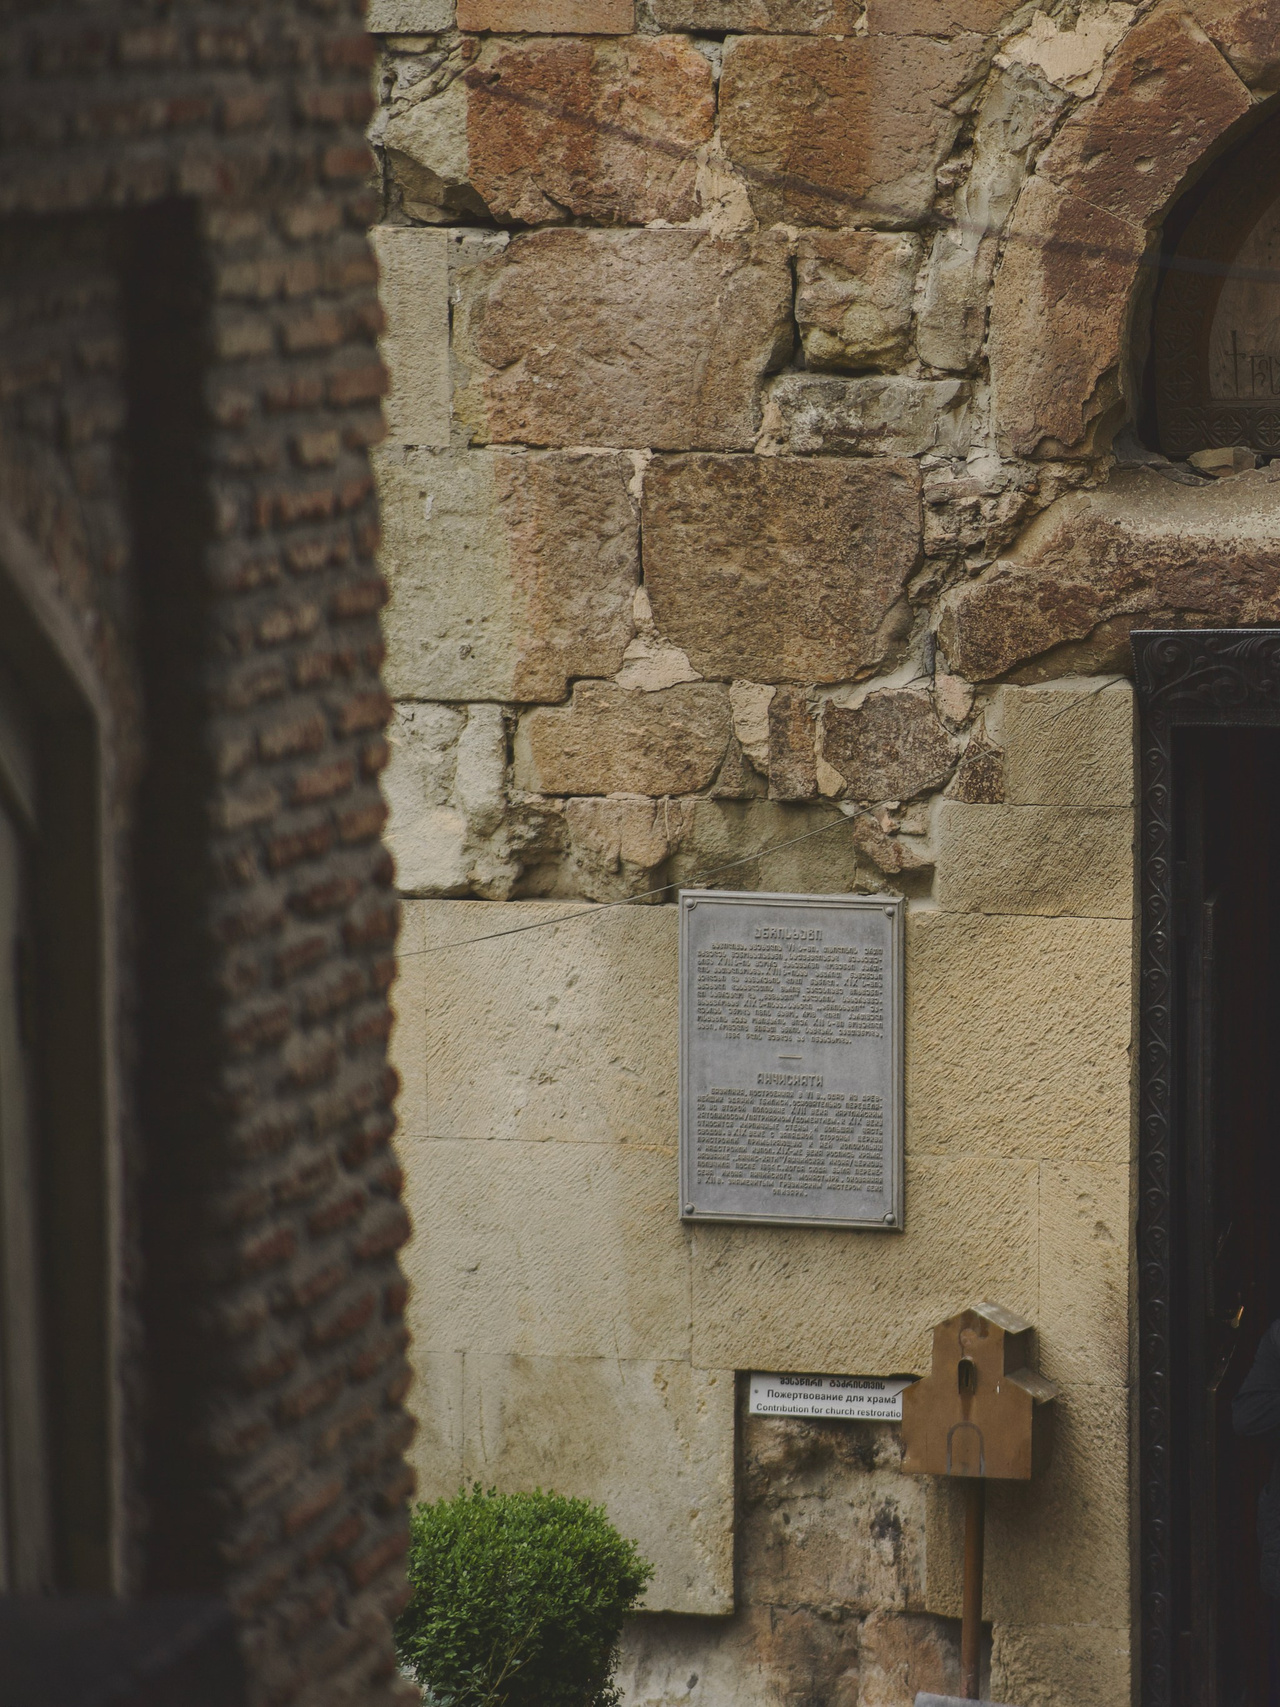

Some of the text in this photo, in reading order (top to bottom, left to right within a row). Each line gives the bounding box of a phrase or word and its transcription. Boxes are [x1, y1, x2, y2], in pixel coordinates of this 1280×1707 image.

[757, 1072, 824, 1087] АНЧИСХАТИ
[766, 1389, 896, 1405] Пожертвование для храма
[755, 1402, 809, 1413] Contribution
[811, 1405, 823, 1414] for
[825, 1407, 855, 1416] church
